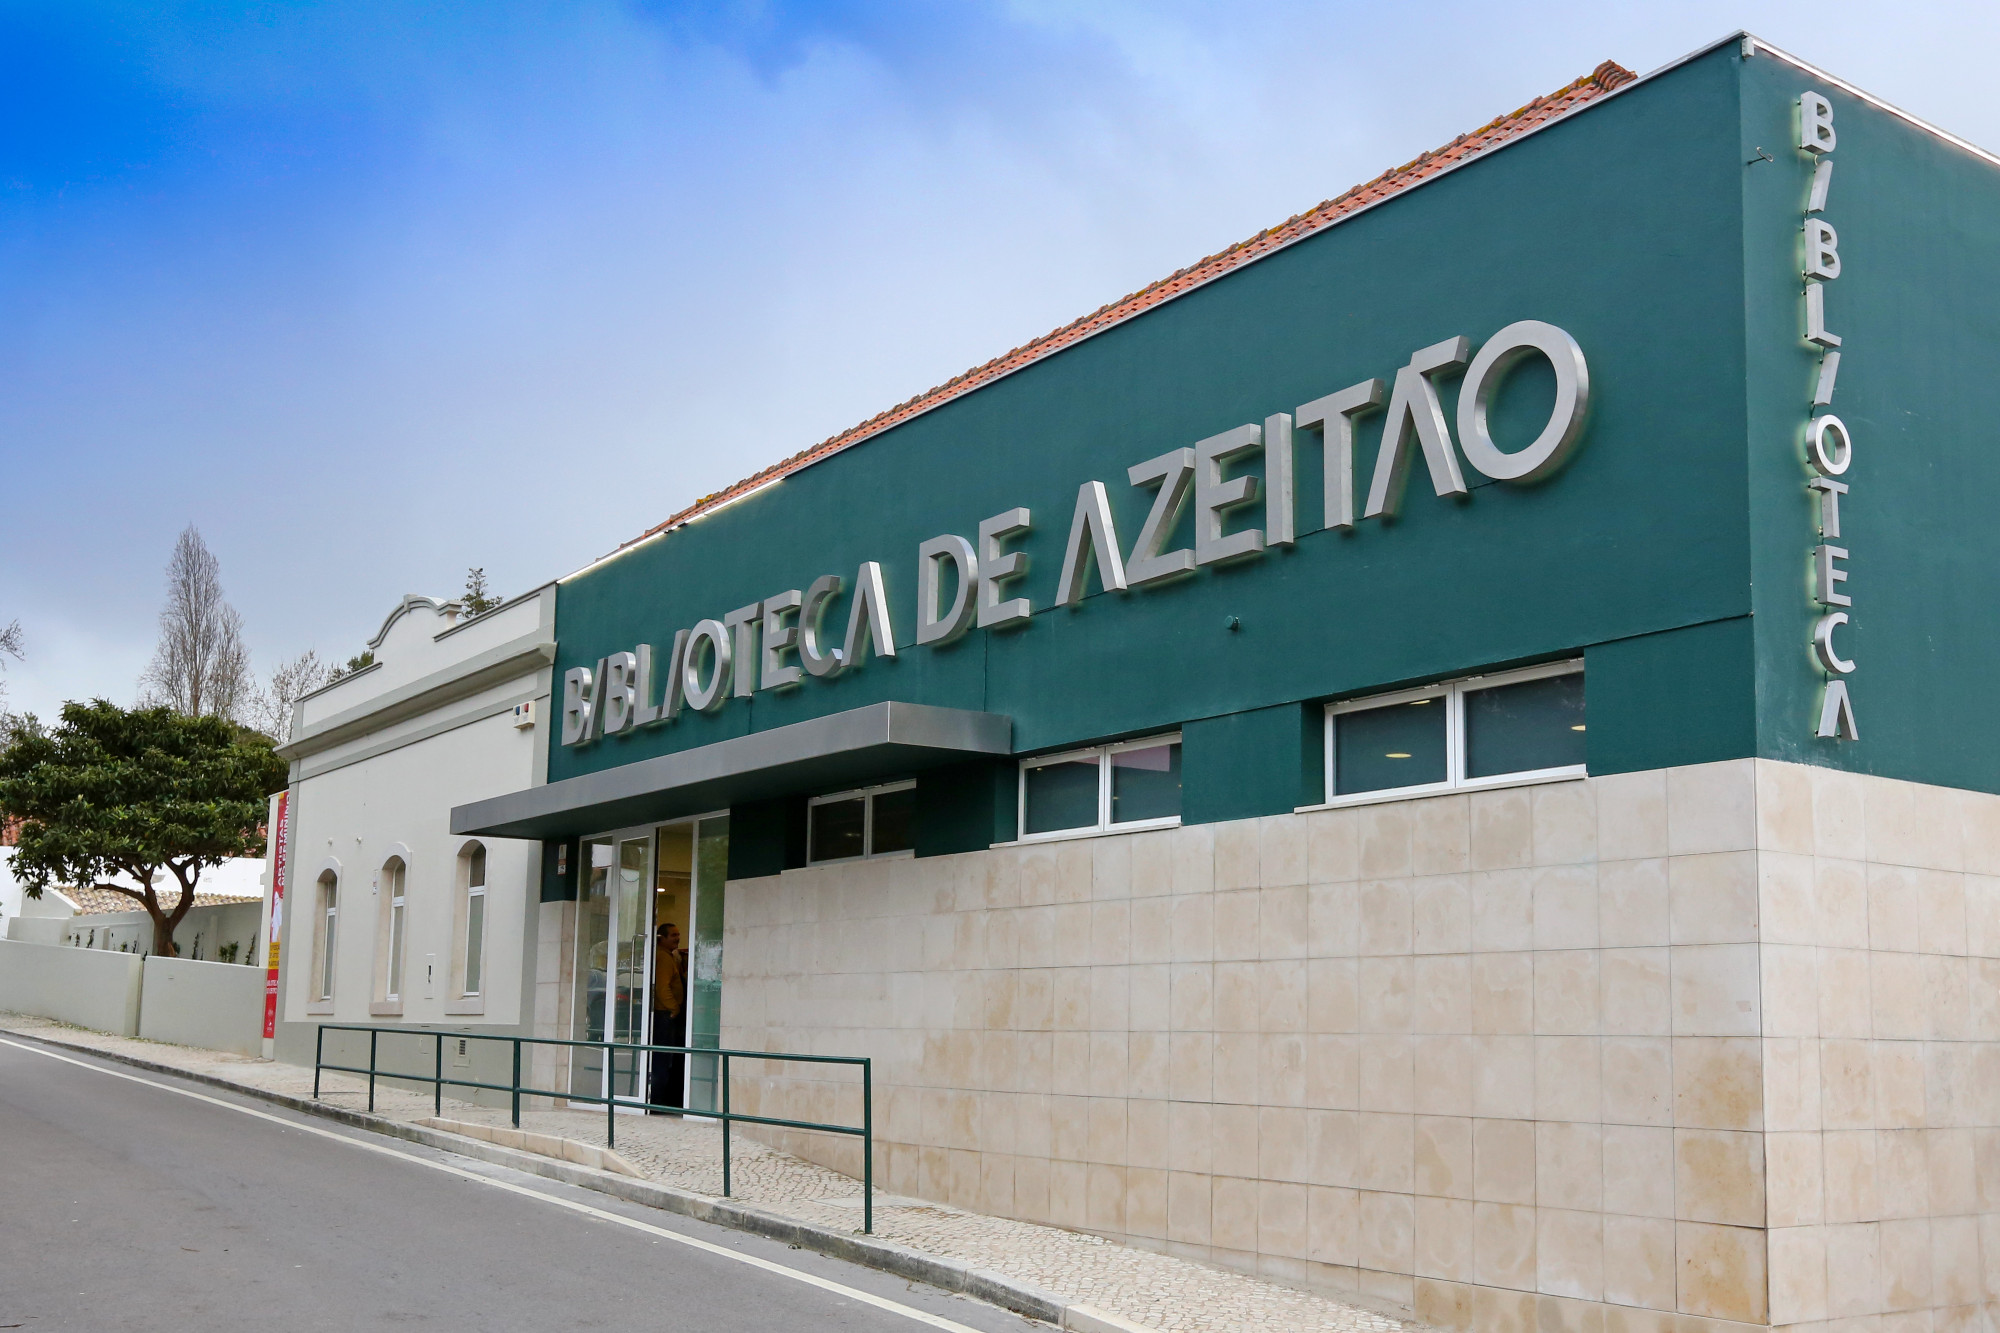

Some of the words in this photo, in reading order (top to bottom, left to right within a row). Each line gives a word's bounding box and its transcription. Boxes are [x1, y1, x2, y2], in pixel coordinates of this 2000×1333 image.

[561, 560, 896, 747] BIBLIOTECA
[917, 507, 1030, 645] DE
[1055, 320, 1590, 607] AZEITÃO
[1800, 91, 1859, 742] BIBLIOTECA
